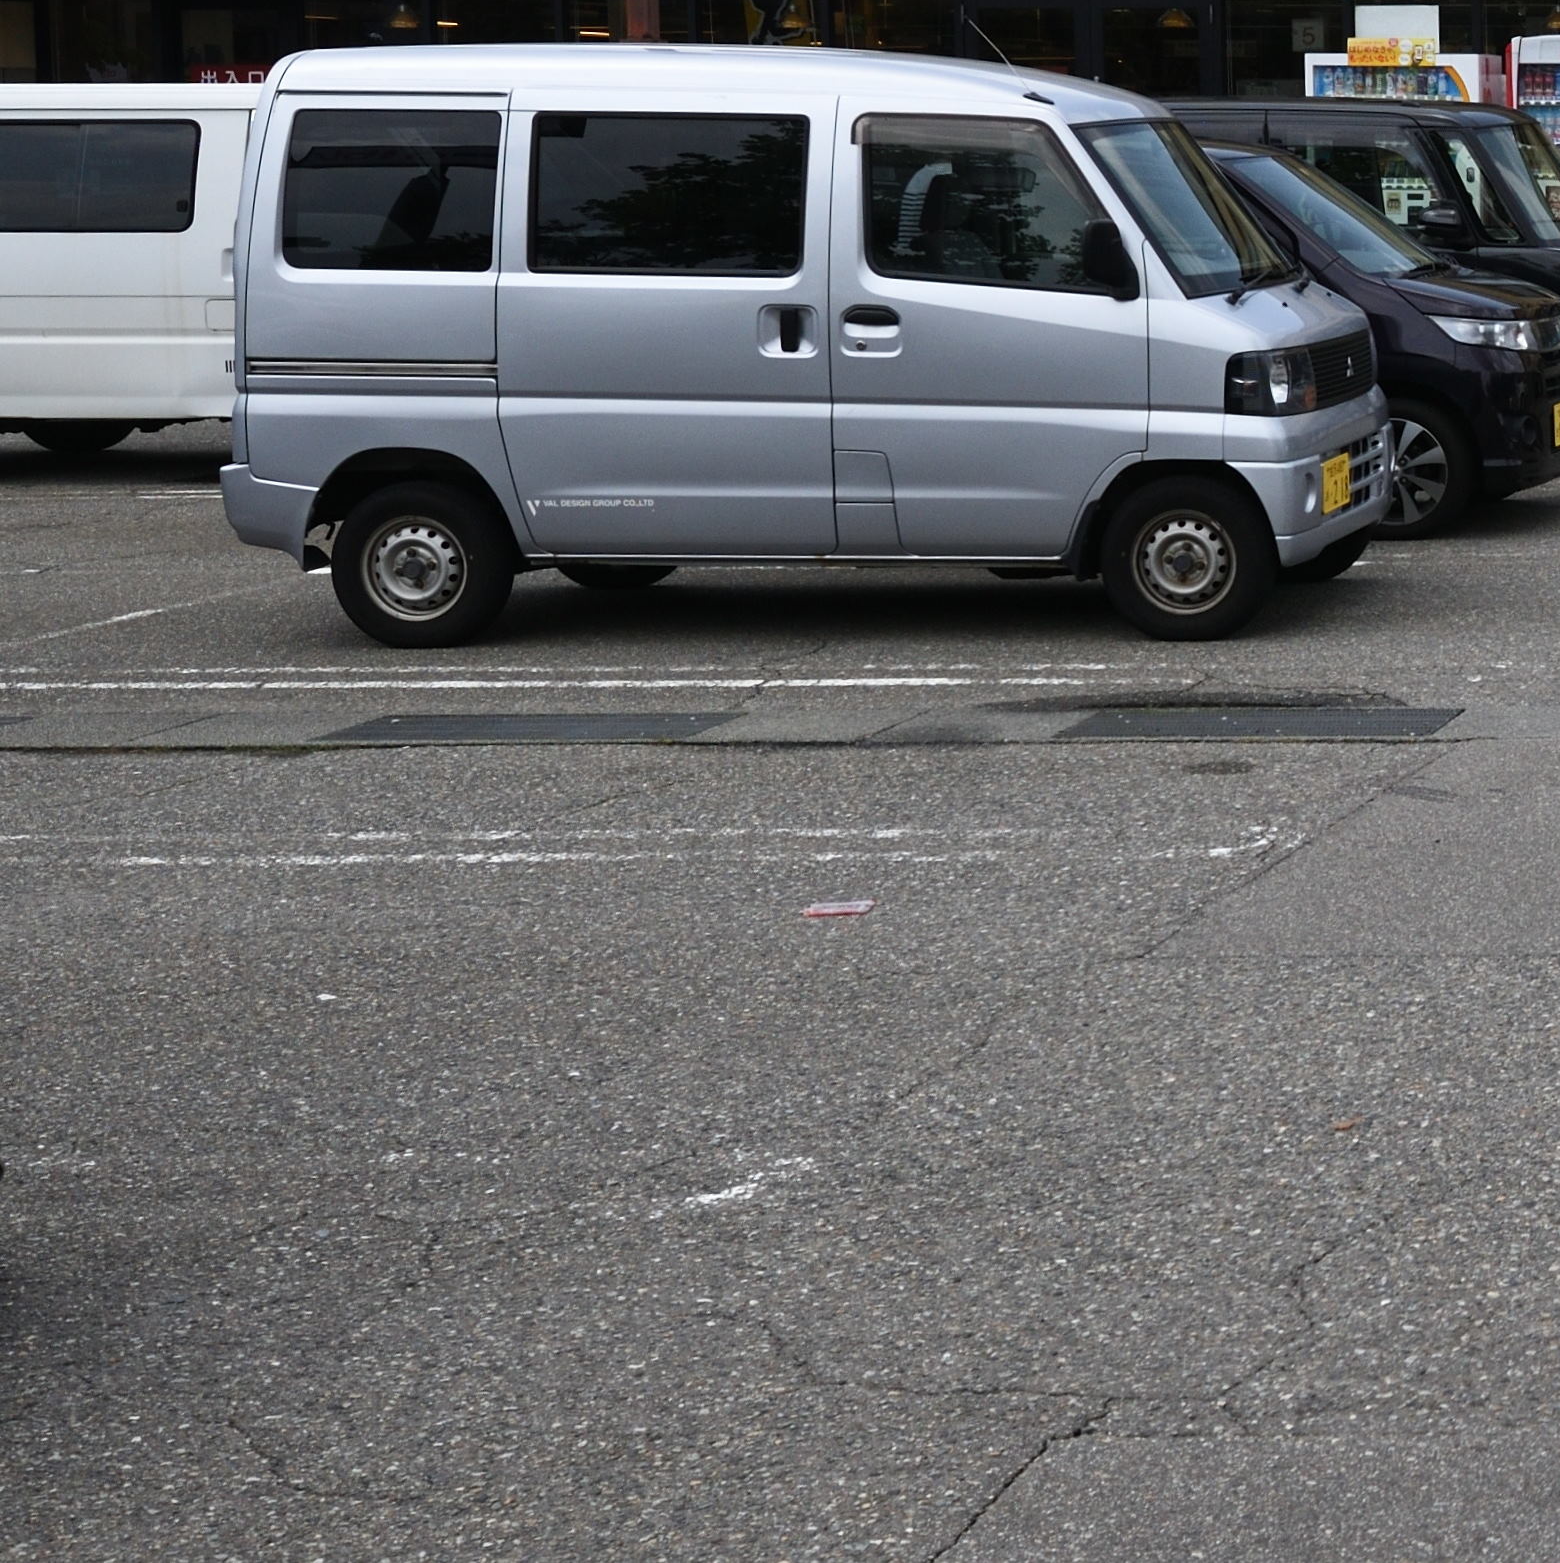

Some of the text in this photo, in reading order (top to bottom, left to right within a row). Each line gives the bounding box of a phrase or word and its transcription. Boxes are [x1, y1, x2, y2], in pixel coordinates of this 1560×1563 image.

[1302, 27, 1316, 47] 5
[560, 499, 591, 508] DESIGN
[592, 499, 622, 508] GROUP
